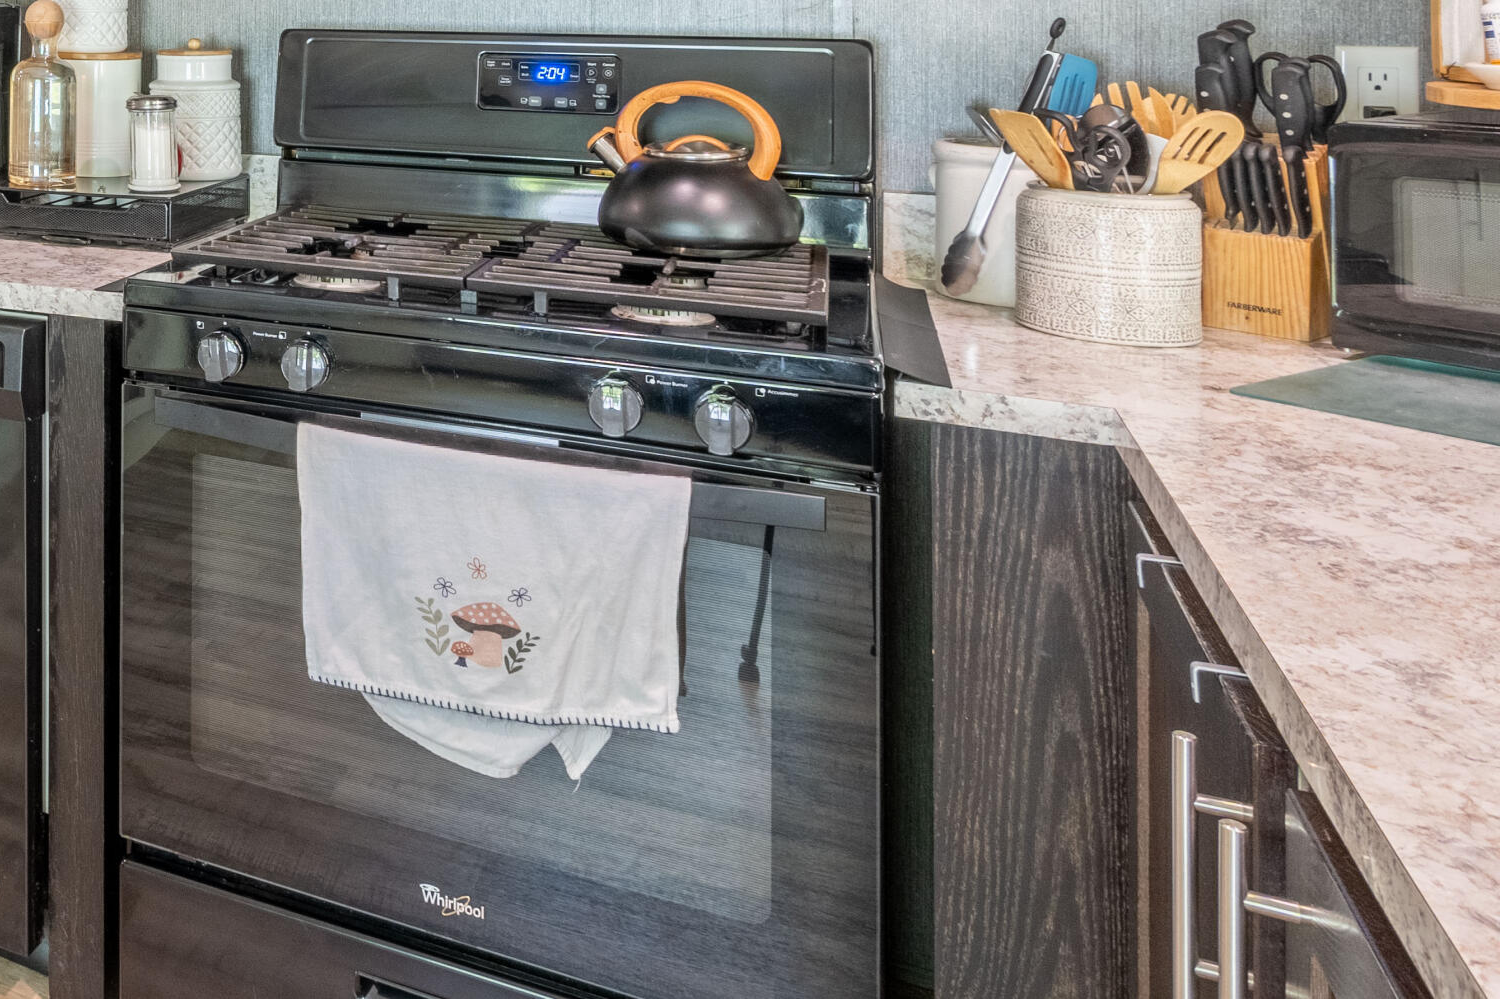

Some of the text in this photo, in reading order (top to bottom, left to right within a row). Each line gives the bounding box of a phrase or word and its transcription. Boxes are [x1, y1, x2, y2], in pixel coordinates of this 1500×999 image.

[536, 66, 566, 81] 2:04
[1227, 301, 1283, 316] FARBERWARE
[419, 883, 485, 920] Whirlpool
